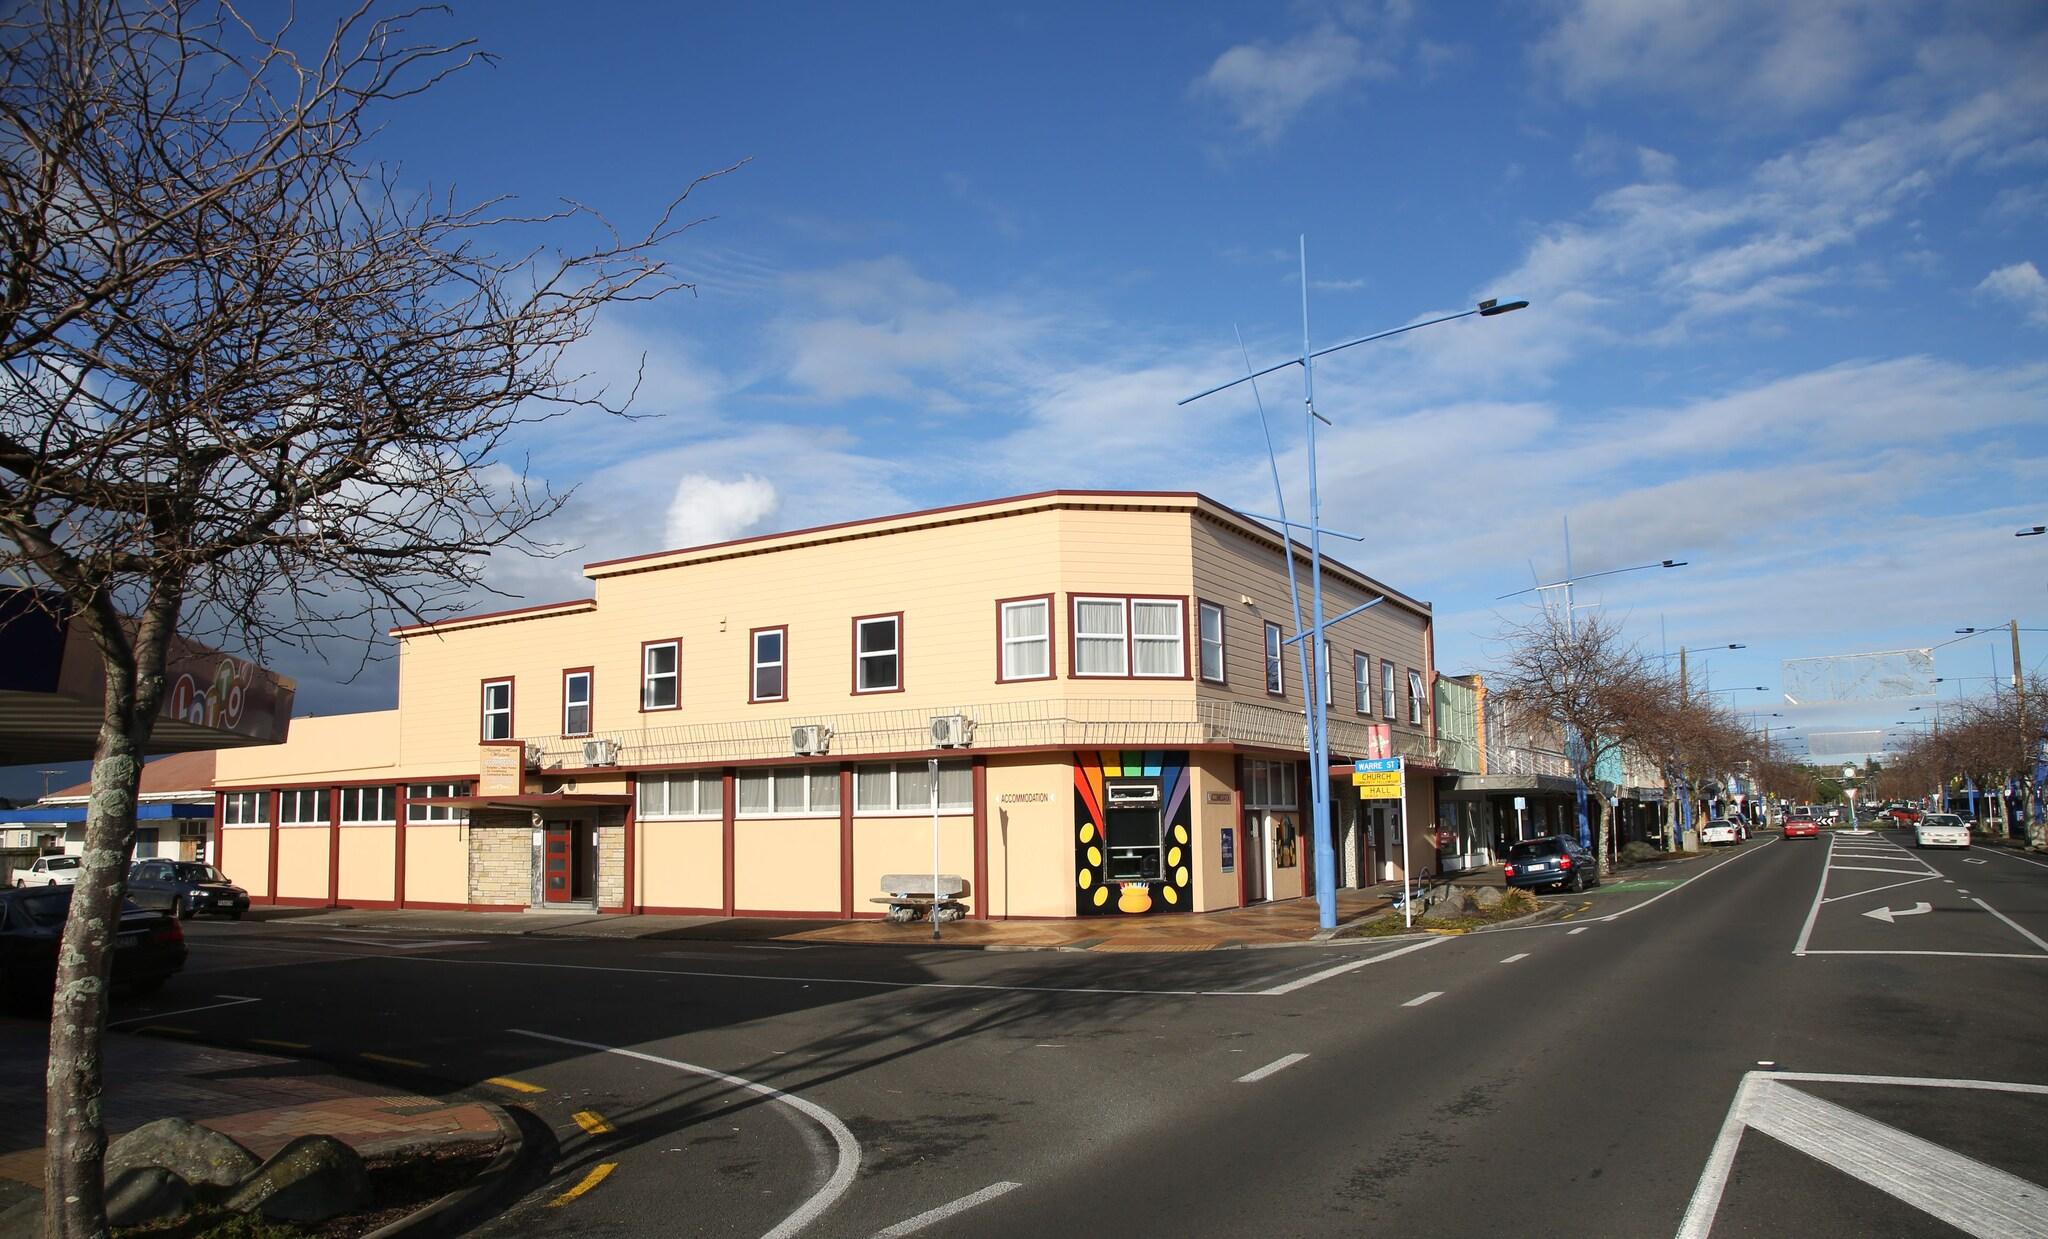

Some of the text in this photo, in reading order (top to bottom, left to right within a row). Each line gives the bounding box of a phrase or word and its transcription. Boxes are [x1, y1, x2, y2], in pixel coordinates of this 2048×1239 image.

[175, 665, 243, 728] LOTTO
[1359, 760, 1396, 771] WARRE ST
[1361, 773, 1392, 781] CHURCH
[1001, 793, 1049, 803] ACCOMMODATION
